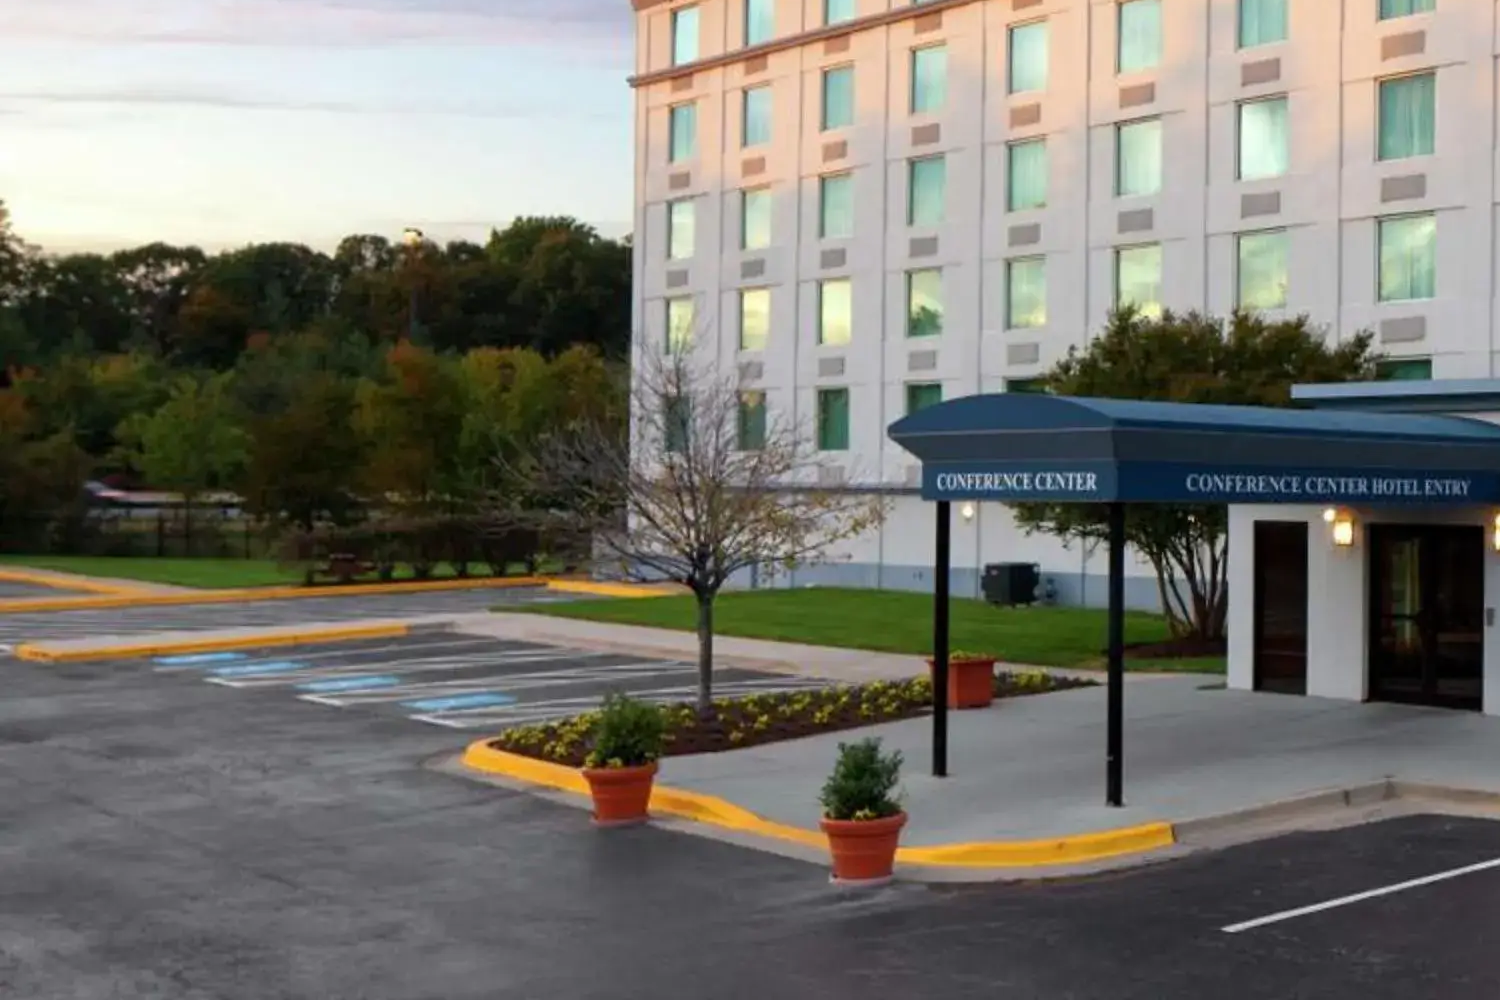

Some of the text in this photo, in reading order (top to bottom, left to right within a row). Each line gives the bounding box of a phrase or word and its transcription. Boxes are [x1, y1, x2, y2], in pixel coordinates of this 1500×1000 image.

[936, 471, 1098, 492] CONFERENCE CENTER
[1185, 472, 1471, 496] CONFERENCE CENTER HOTEL ENTRY
